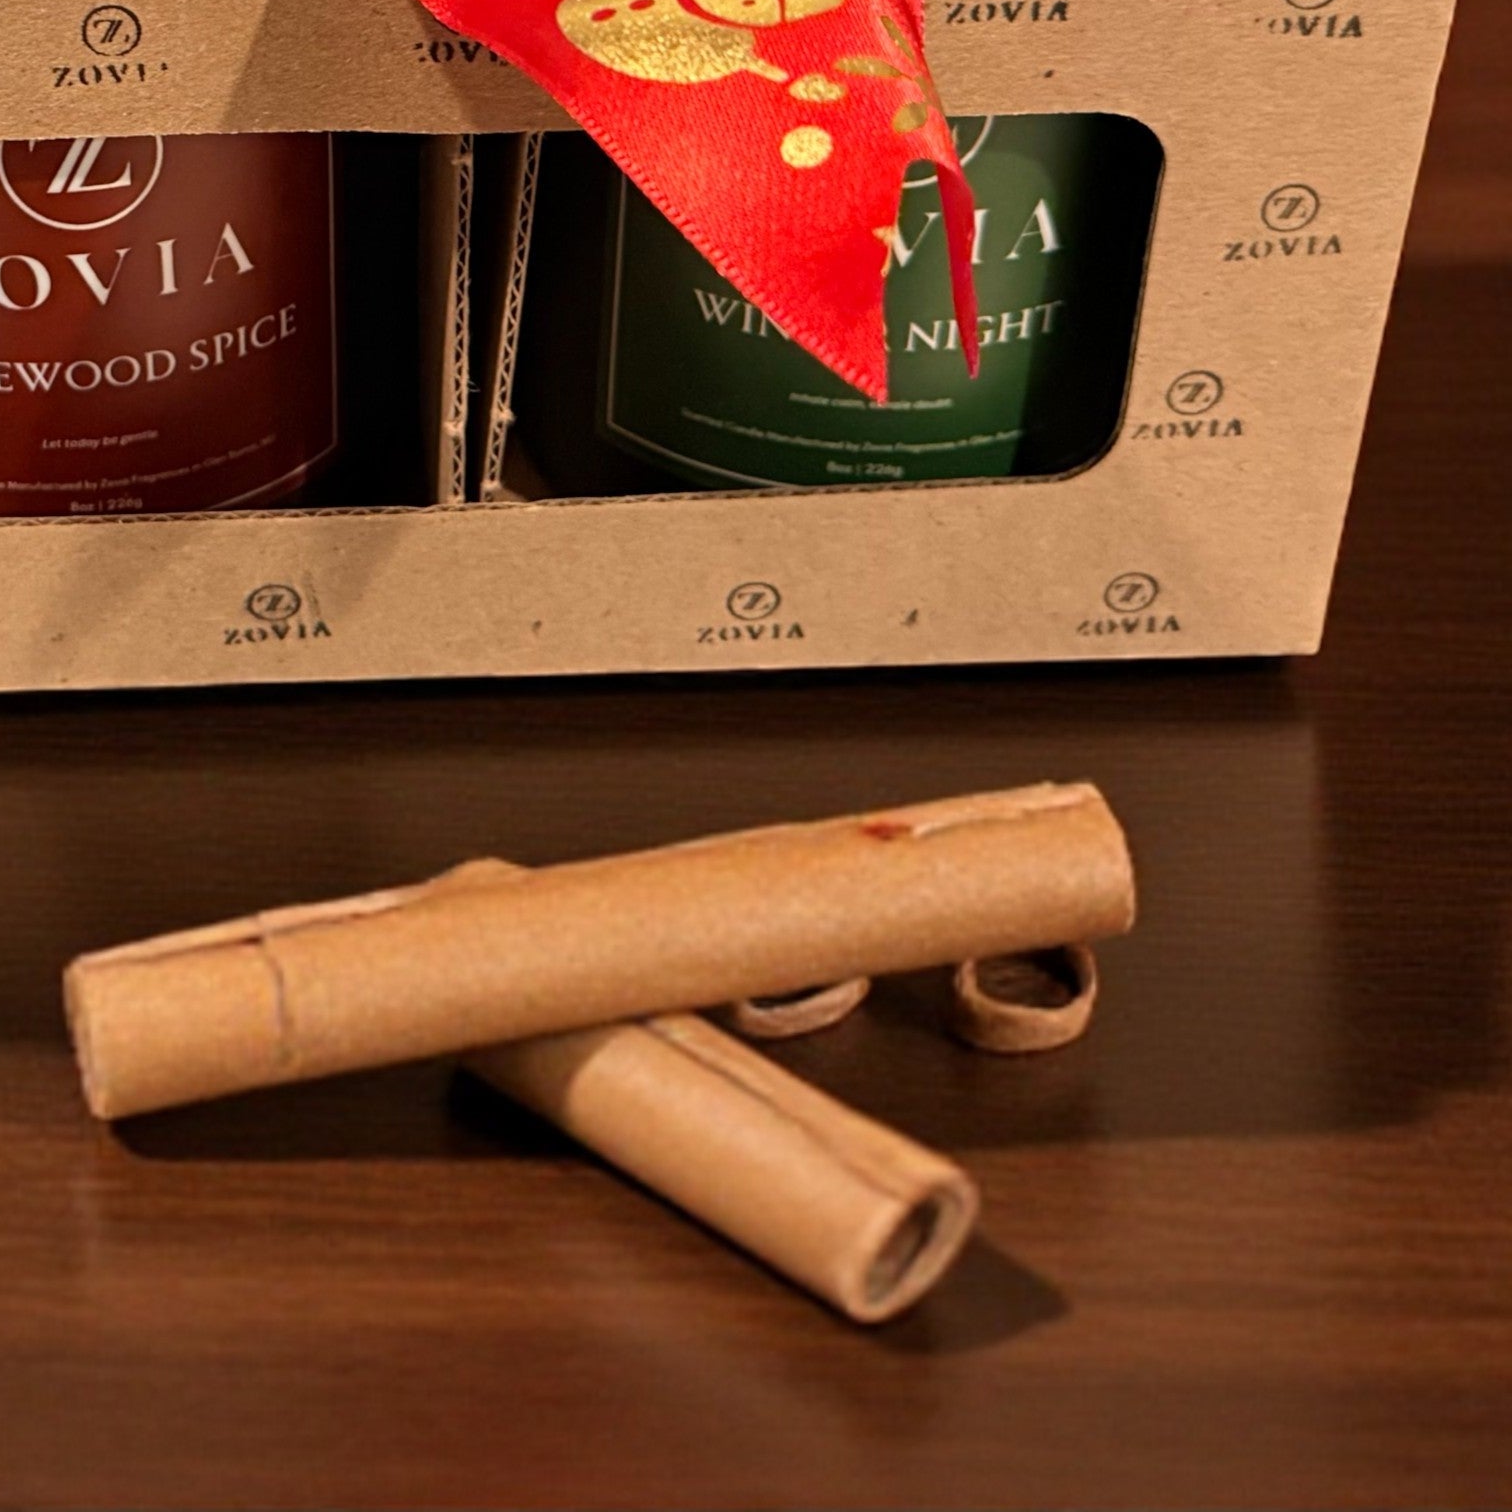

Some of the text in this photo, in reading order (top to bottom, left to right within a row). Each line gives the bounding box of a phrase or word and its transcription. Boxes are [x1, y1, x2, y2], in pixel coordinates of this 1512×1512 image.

[1223, 233, 1342, 262] ZOVIA
[189, 303, 298, 372] SPICE
[1130, 418, 1244, 440] ZOVIA
[224, 621, 332, 645] ZOVIA
[696, 622, 804, 644] ZOVIA
